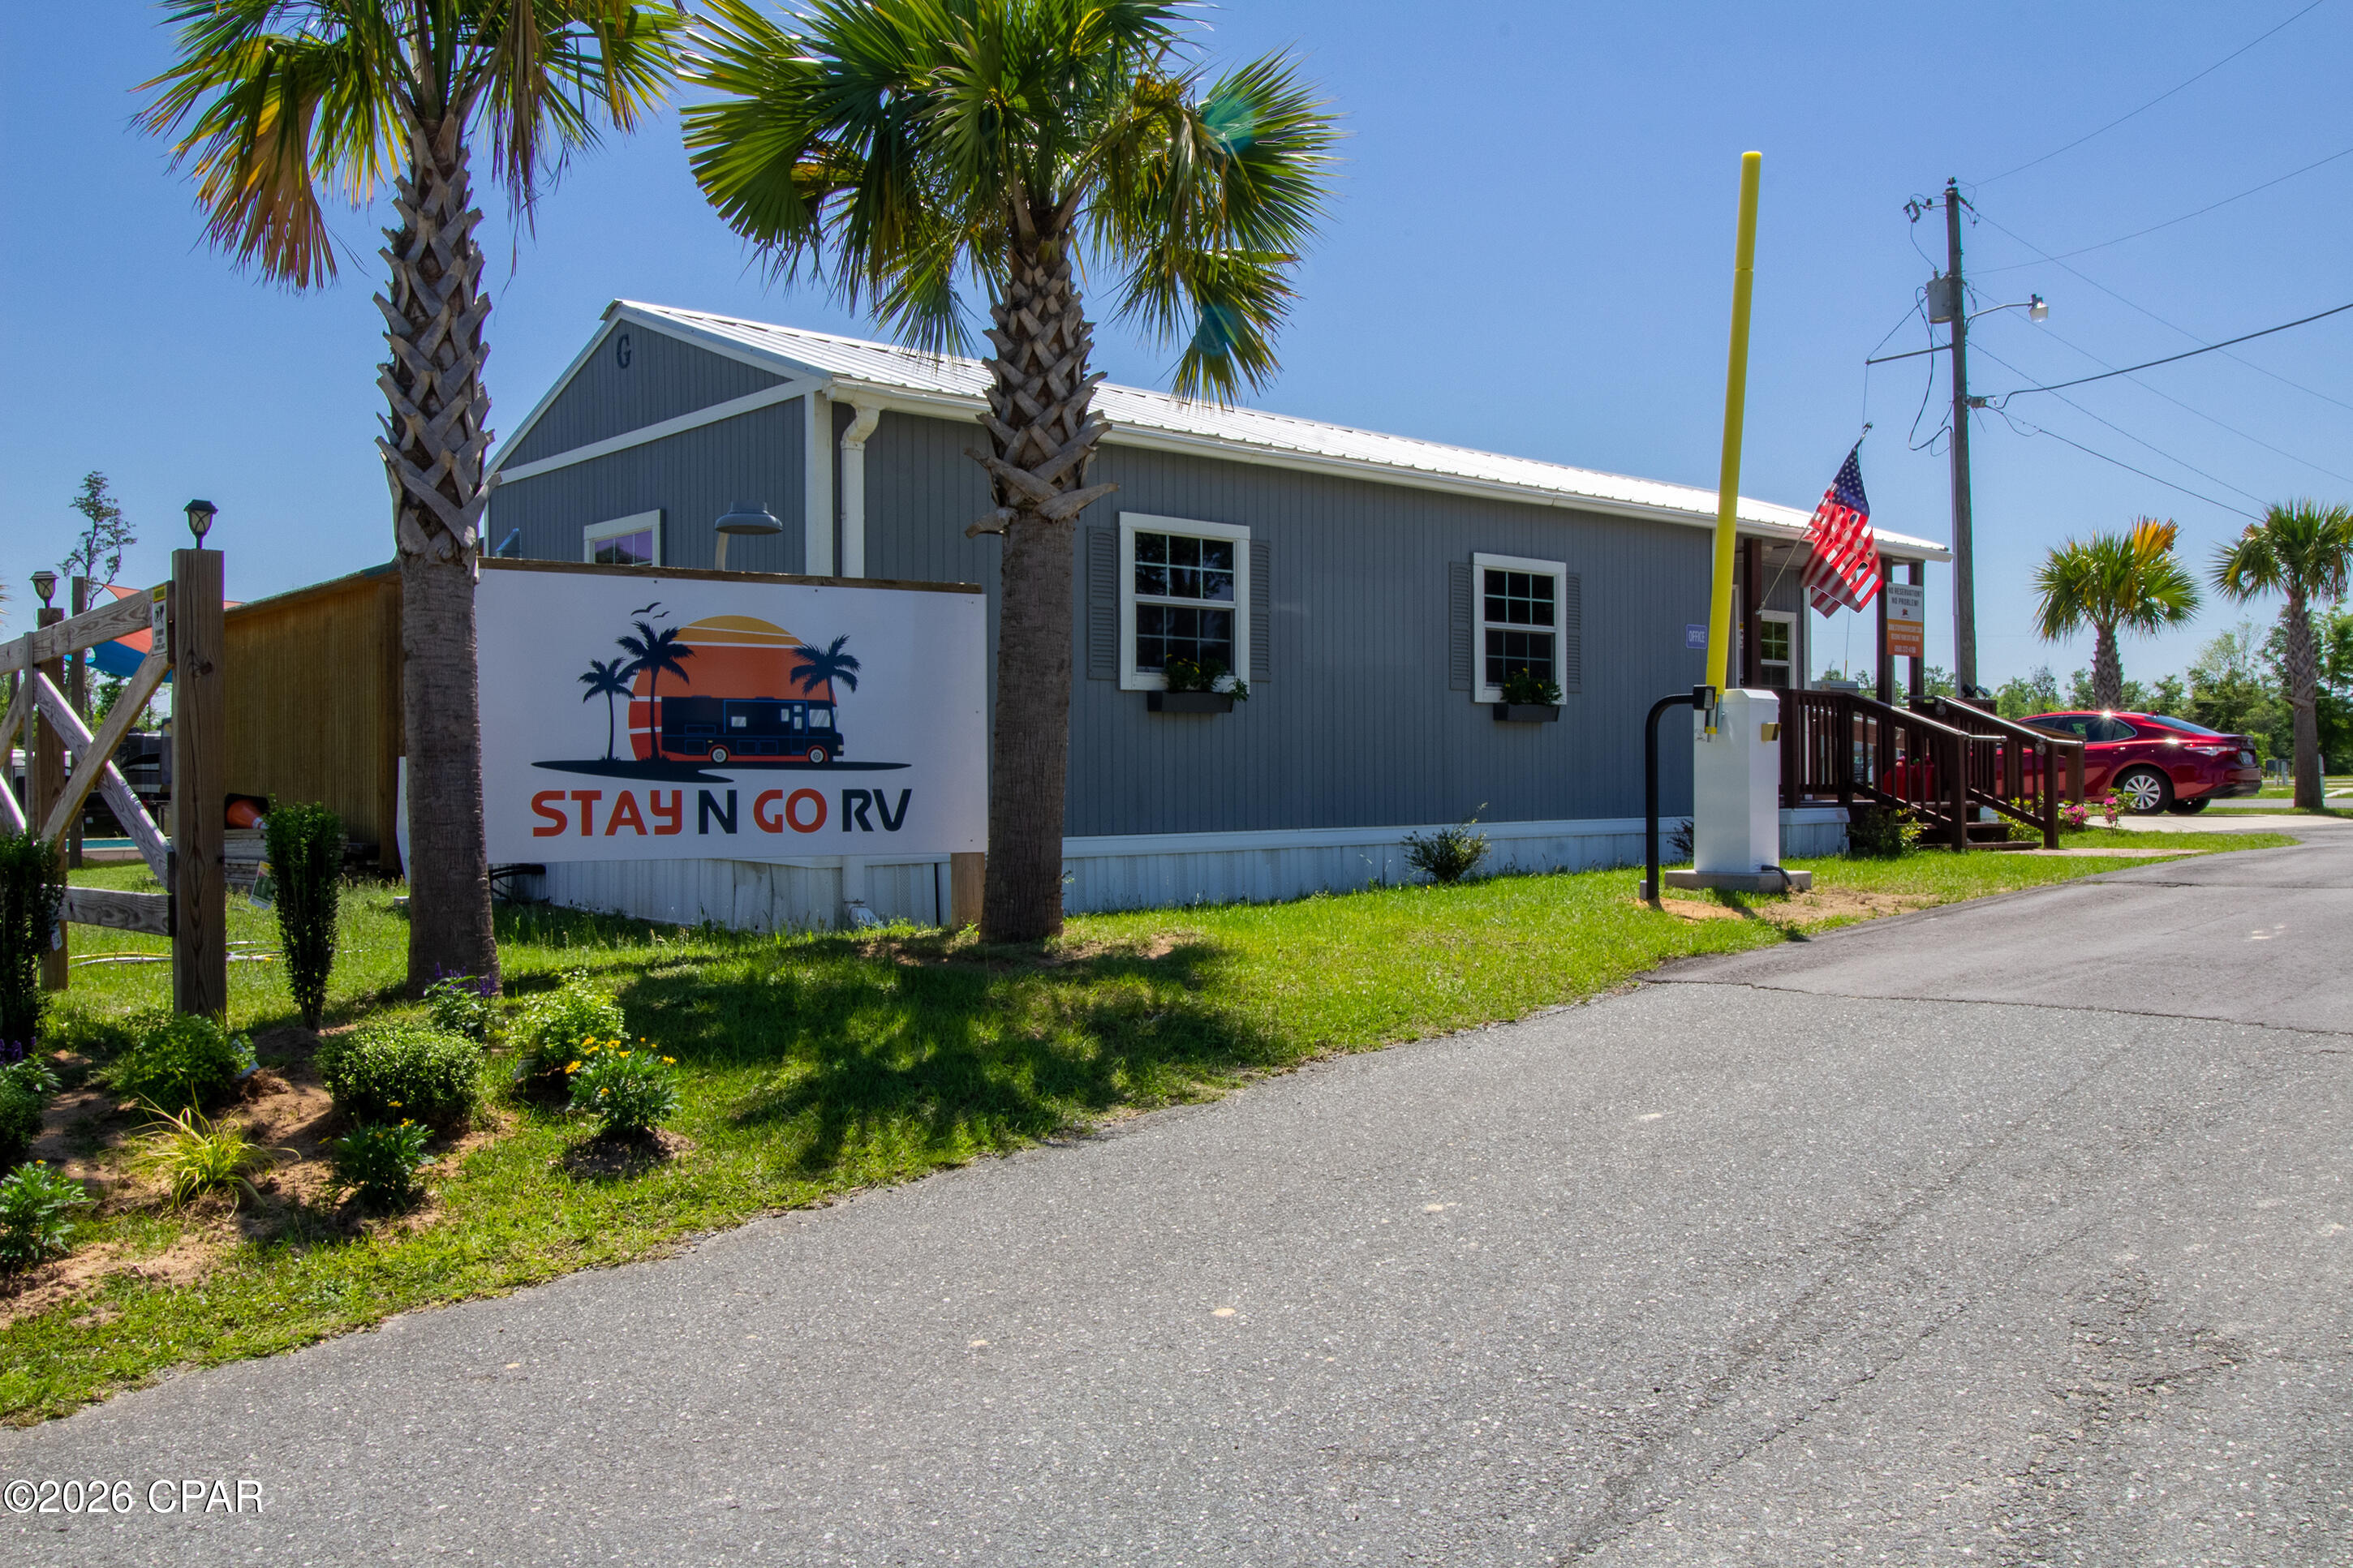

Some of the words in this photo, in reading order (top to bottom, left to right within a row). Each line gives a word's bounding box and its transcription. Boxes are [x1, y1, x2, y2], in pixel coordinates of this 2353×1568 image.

[1895, 588, 1922, 598] RESERVATION?
[1891, 597, 1898, 605] NO
[1688, 629, 1705, 642] OFFICE
[531, 788, 682, 837] STAY
[698, 789, 738, 835] N
[753, 788, 828, 834] GO
[842, 788, 912, 832] RV
